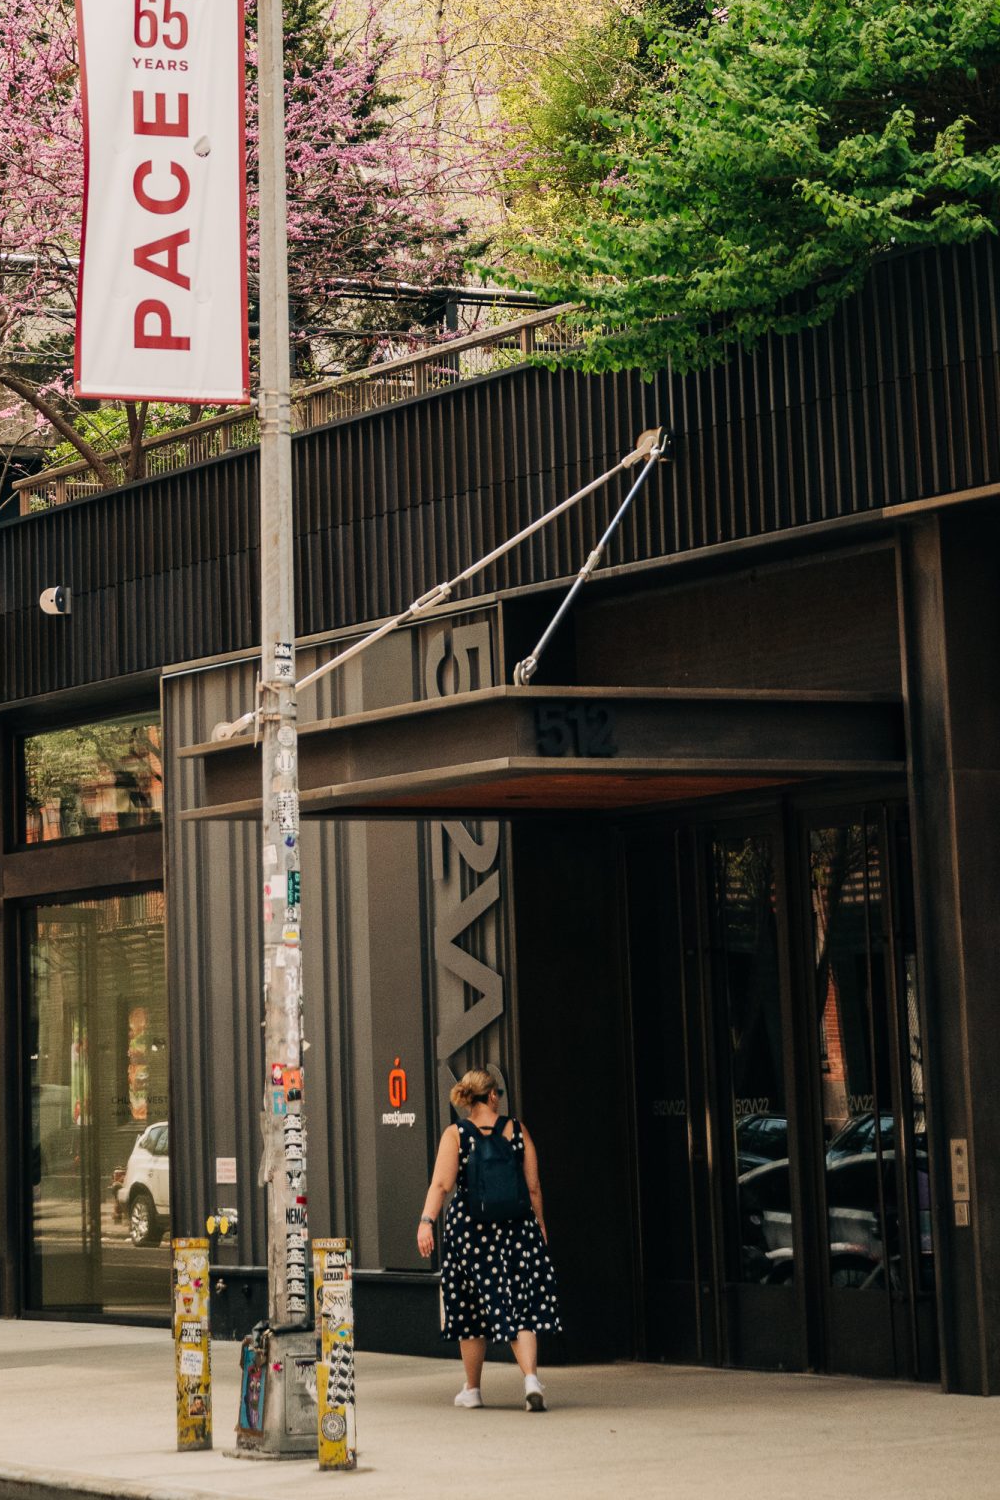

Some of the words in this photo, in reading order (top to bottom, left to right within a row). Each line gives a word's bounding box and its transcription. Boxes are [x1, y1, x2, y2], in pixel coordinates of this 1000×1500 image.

[132, 57, 189, 72] YEARS
[132, 90, 191, 351] PACE
[536, 704, 618, 758] 512
[382, 1111, 416, 1127] nextjump
